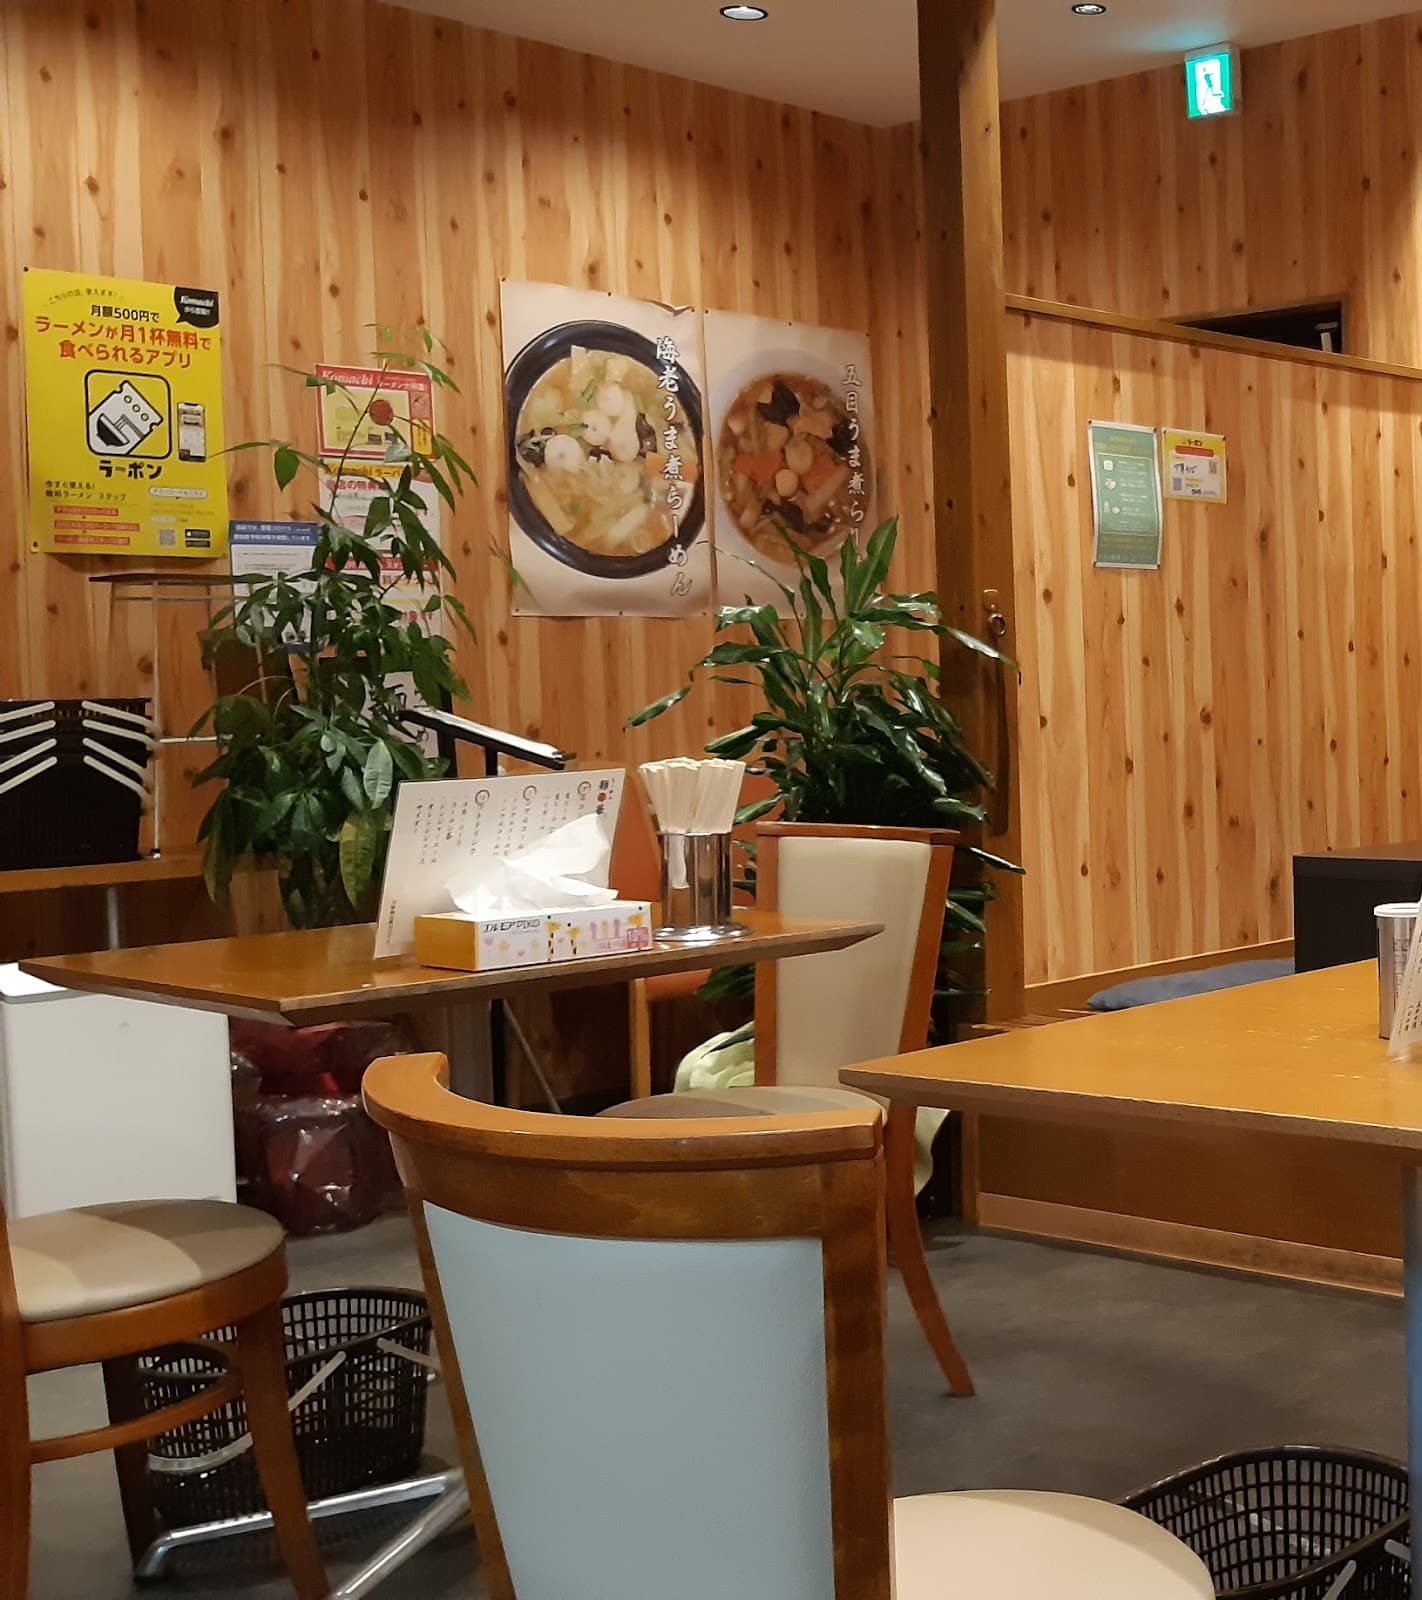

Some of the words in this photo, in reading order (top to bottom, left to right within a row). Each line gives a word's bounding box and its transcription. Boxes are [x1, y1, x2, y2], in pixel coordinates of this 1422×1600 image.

[91, 305, 160, 323] 月額500円で
[35, 316, 211, 351] ラーメンが月1杯無料で
[59, 340, 192, 368] 食べられるアプリ
[99, 460, 162, 479] ラーポン
[655, 337, 693, 597] 海老うま煮らーめん
